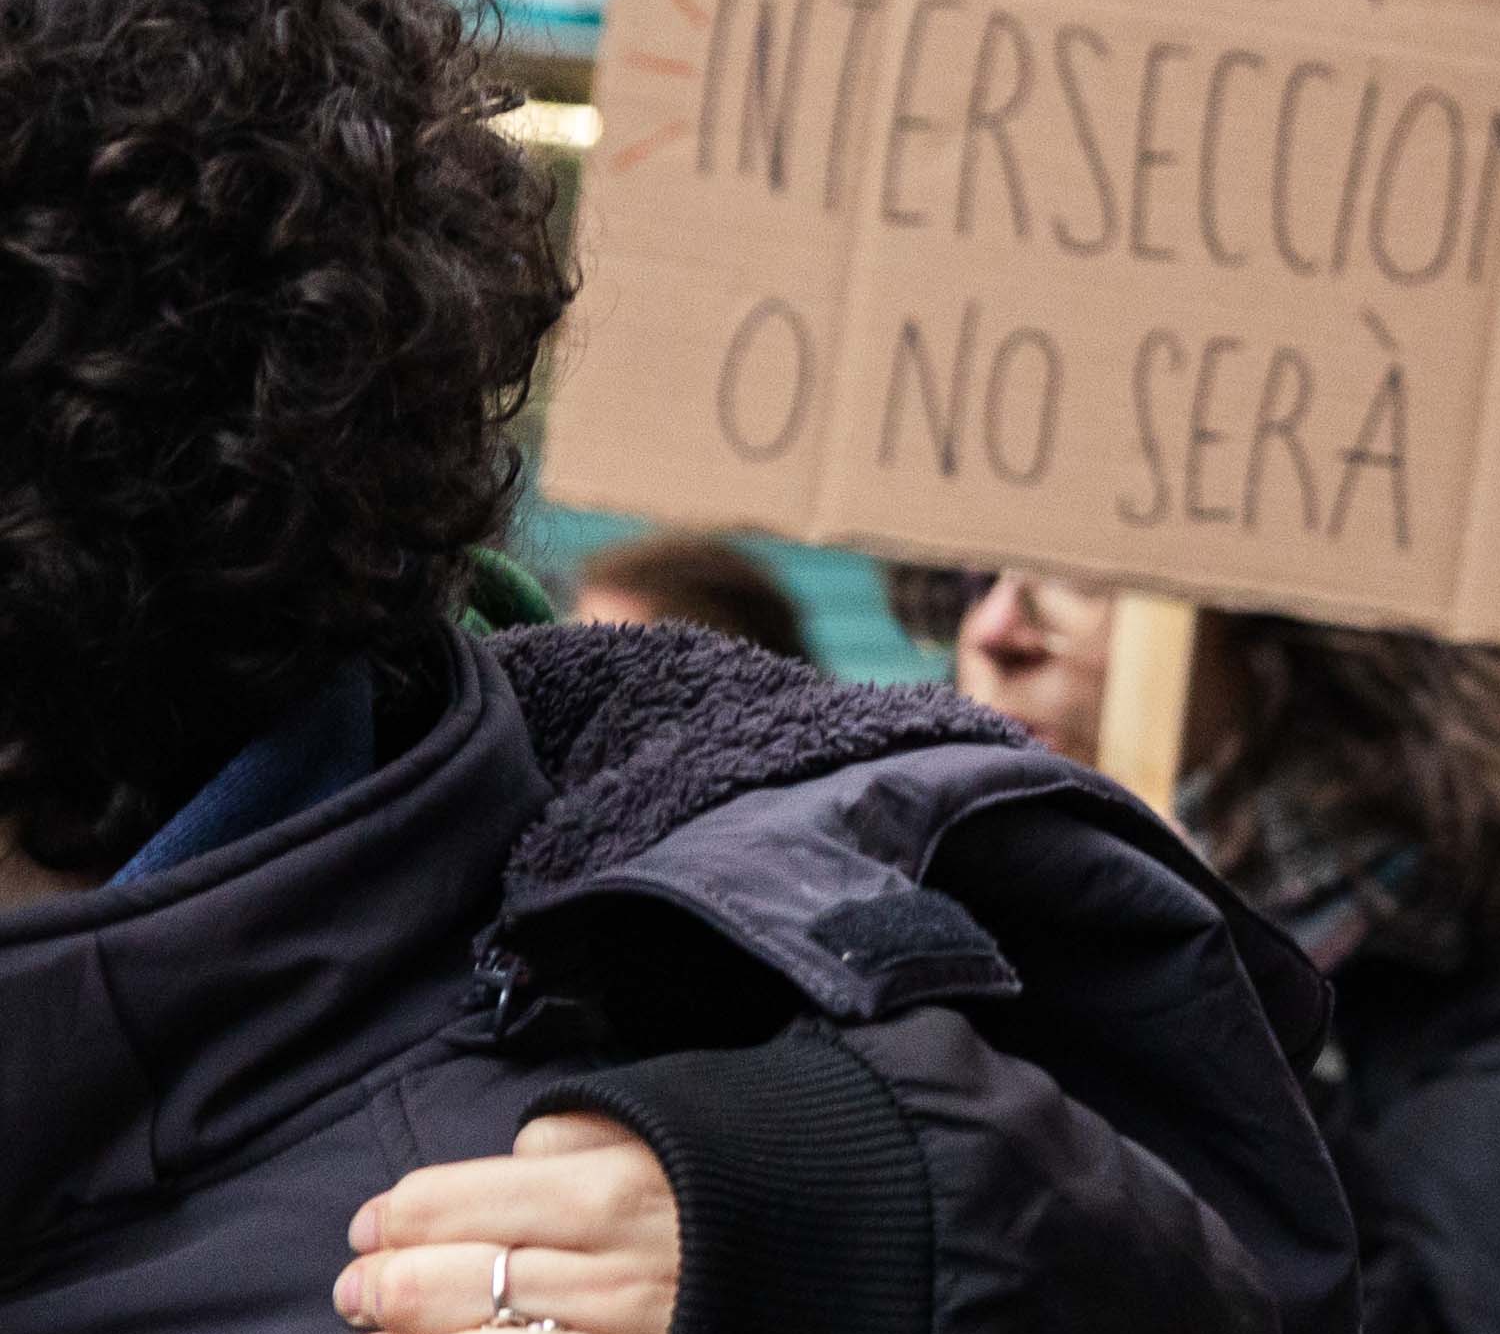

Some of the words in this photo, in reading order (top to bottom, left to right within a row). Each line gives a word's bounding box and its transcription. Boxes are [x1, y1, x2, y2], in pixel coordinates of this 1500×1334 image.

[716, 297, 815, 461] O
[879, 302, 1064, 487] NO
[1117, 309, 1412, 550] SERÀ
